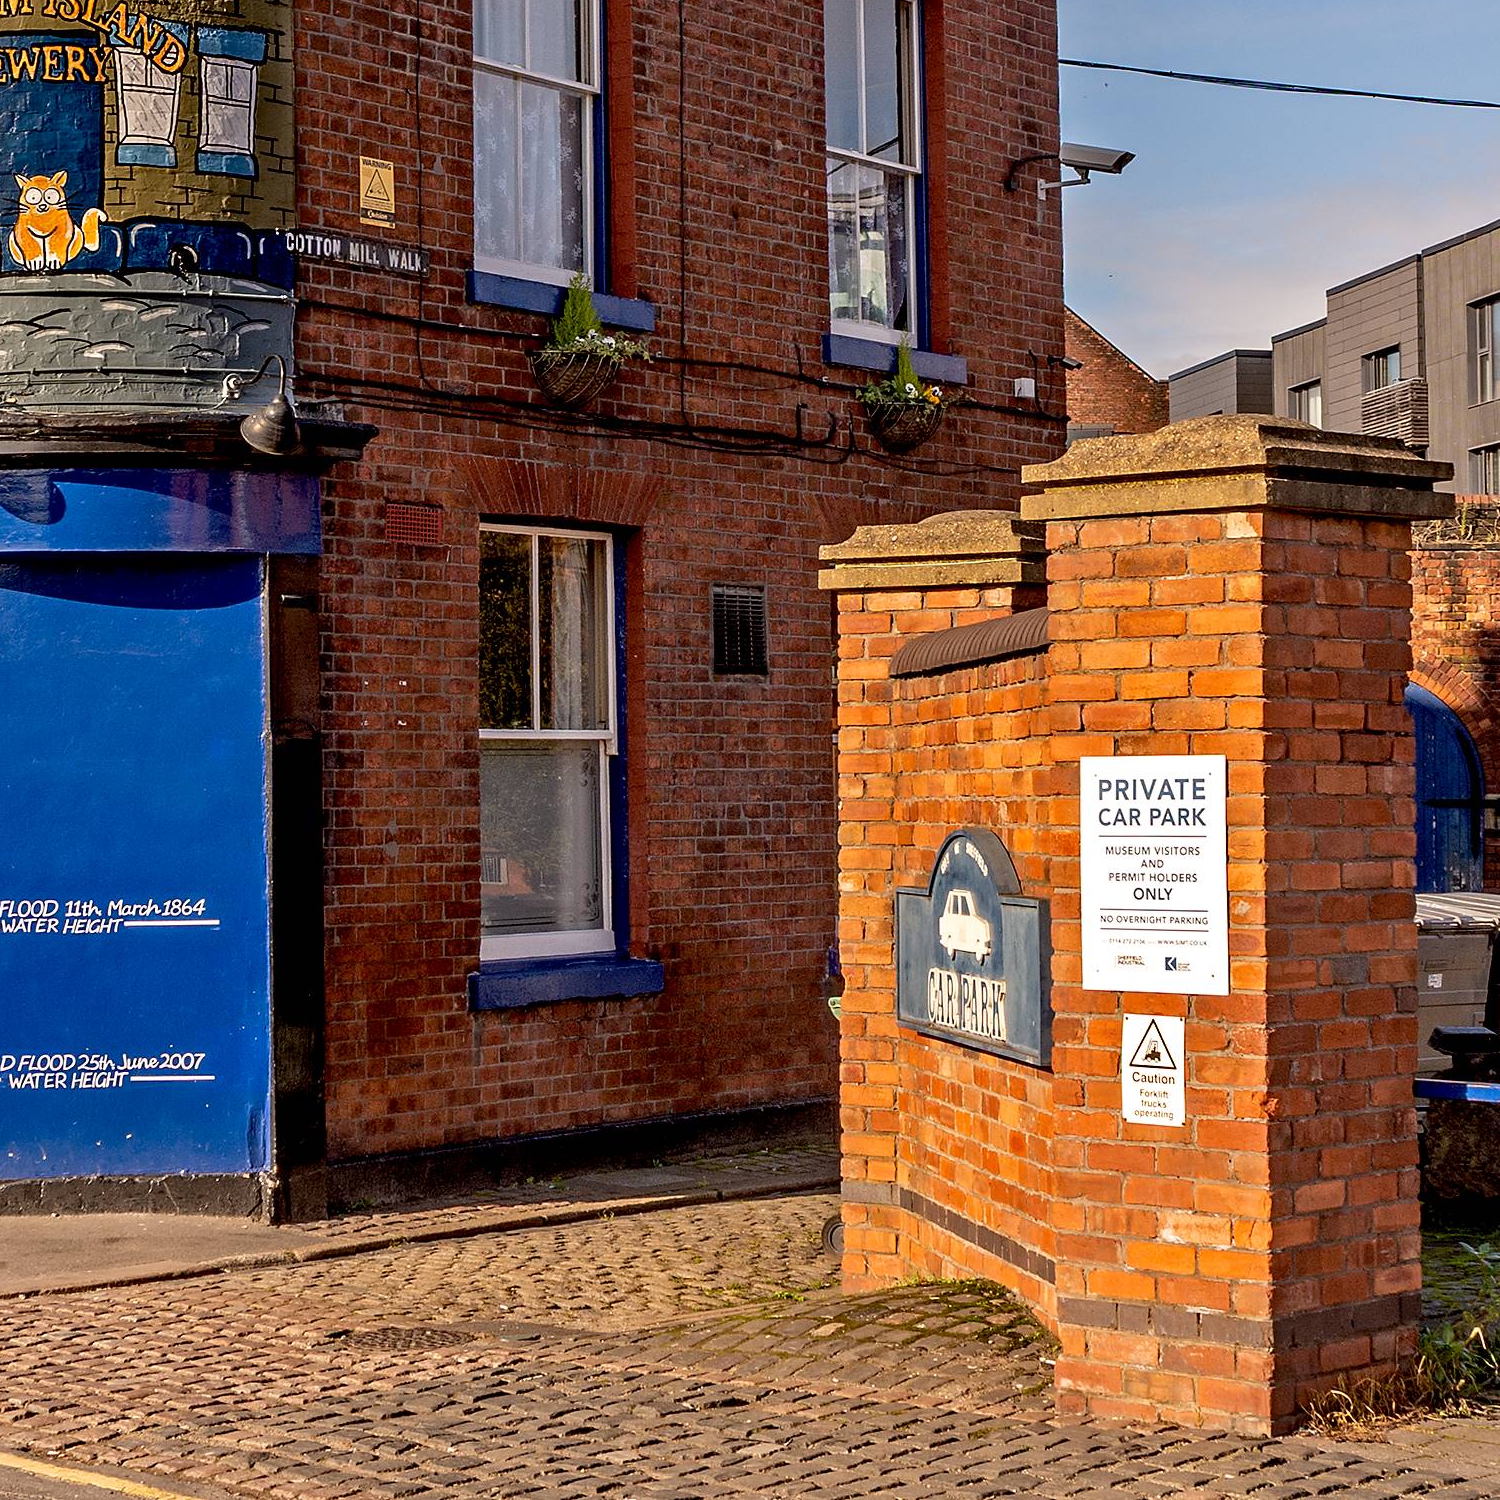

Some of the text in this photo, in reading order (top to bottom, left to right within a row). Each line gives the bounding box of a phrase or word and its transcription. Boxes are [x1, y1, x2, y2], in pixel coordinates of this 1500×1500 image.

[361, 157, 393, 172] WARNING
[286, 232, 341, 259] COTTON
[350, 242, 380, 265] MILL
[1099, 778, 1206, 801] PRIVATE
[1098, 808, 1207, 827] CAR PARK
[1105, 846, 1200, 856] MUSEUM VISITORS
[1141, 859, 1164, 869] AND
[1108, 872, 1198, 883] PERMIT HOLDERS
[1133, 887, 1173, 901] ONLY
[0, 899, 59, 918] FLOOD
[107, 899, 161, 917] March
[161, 898, 206, 917] 1864
[1, 917, 124, 935] WATER HEIGHT
[1100, 915, 1209, 925] NO OVERNIGHT PARKING
[926, 967, 1007, 1043] CAR PARK
[17, 1054, 77, 1072] FLOOD
[115, 1053, 159, 1072] June
[159, 1053, 206, 1070] 2007
[8, 1071, 129, 1090] WATER HEIGHT
[1132, 1071, 1176, 1086] Caution
[1139, 1088, 1169, 1100] Forklift
[1141, 1100, 1167, 1109] trucks
[1134, 1109, 1174, 1122] operating
